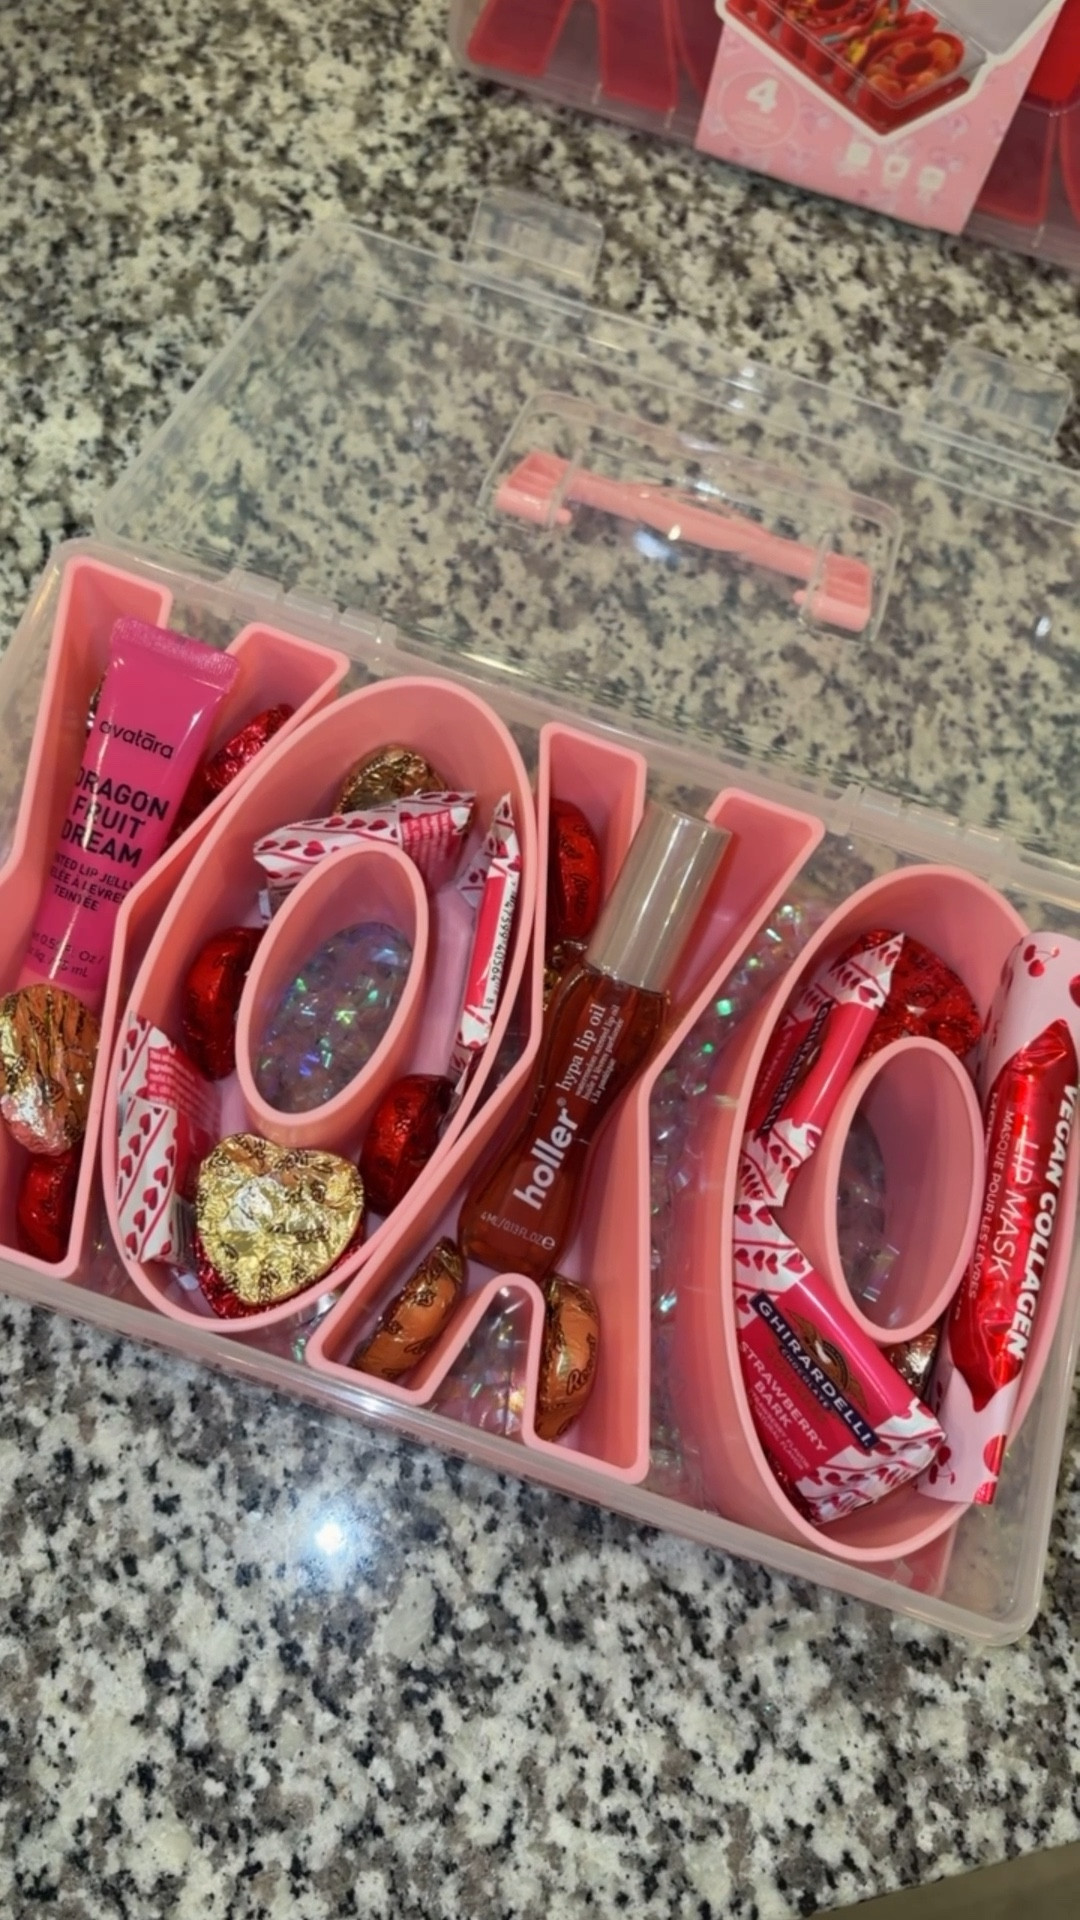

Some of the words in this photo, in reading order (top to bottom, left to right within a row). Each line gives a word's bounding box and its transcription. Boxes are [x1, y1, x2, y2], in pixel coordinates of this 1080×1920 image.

[745, 79, 778, 114] 4
[61, 823, 143, 868] DREAM
[72, 799, 146, 839] FRUIT
[79, 864, 98, 877] LIP
[556, 1055, 584, 1091] hypa
[573, 1030, 596, 1051] lip
[589, 1003, 606, 1026] oil
[513, 1108, 579, 1210] holler
[996, 1109, 1014, 1172] MASQUE
[1013, 1136, 1040, 1185] LIP
[1045, 1084, 1078, 1187] VEGAN
[984, 1173, 1002, 1215] POUR
[977, 1217, 993, 1248] LES
[988, 1189, 1028, 1281] MASK
[1007, 1191, 1057, 1361] COLLAGEN
[740, 1341, 828, 1452] STRAWBERRY
[757, 1300, 870, 1446] GHIRARDELLI
[782, 1348, 832, 1410] CHOCOLATE
[754, 1381, 792, 1429] BARK
